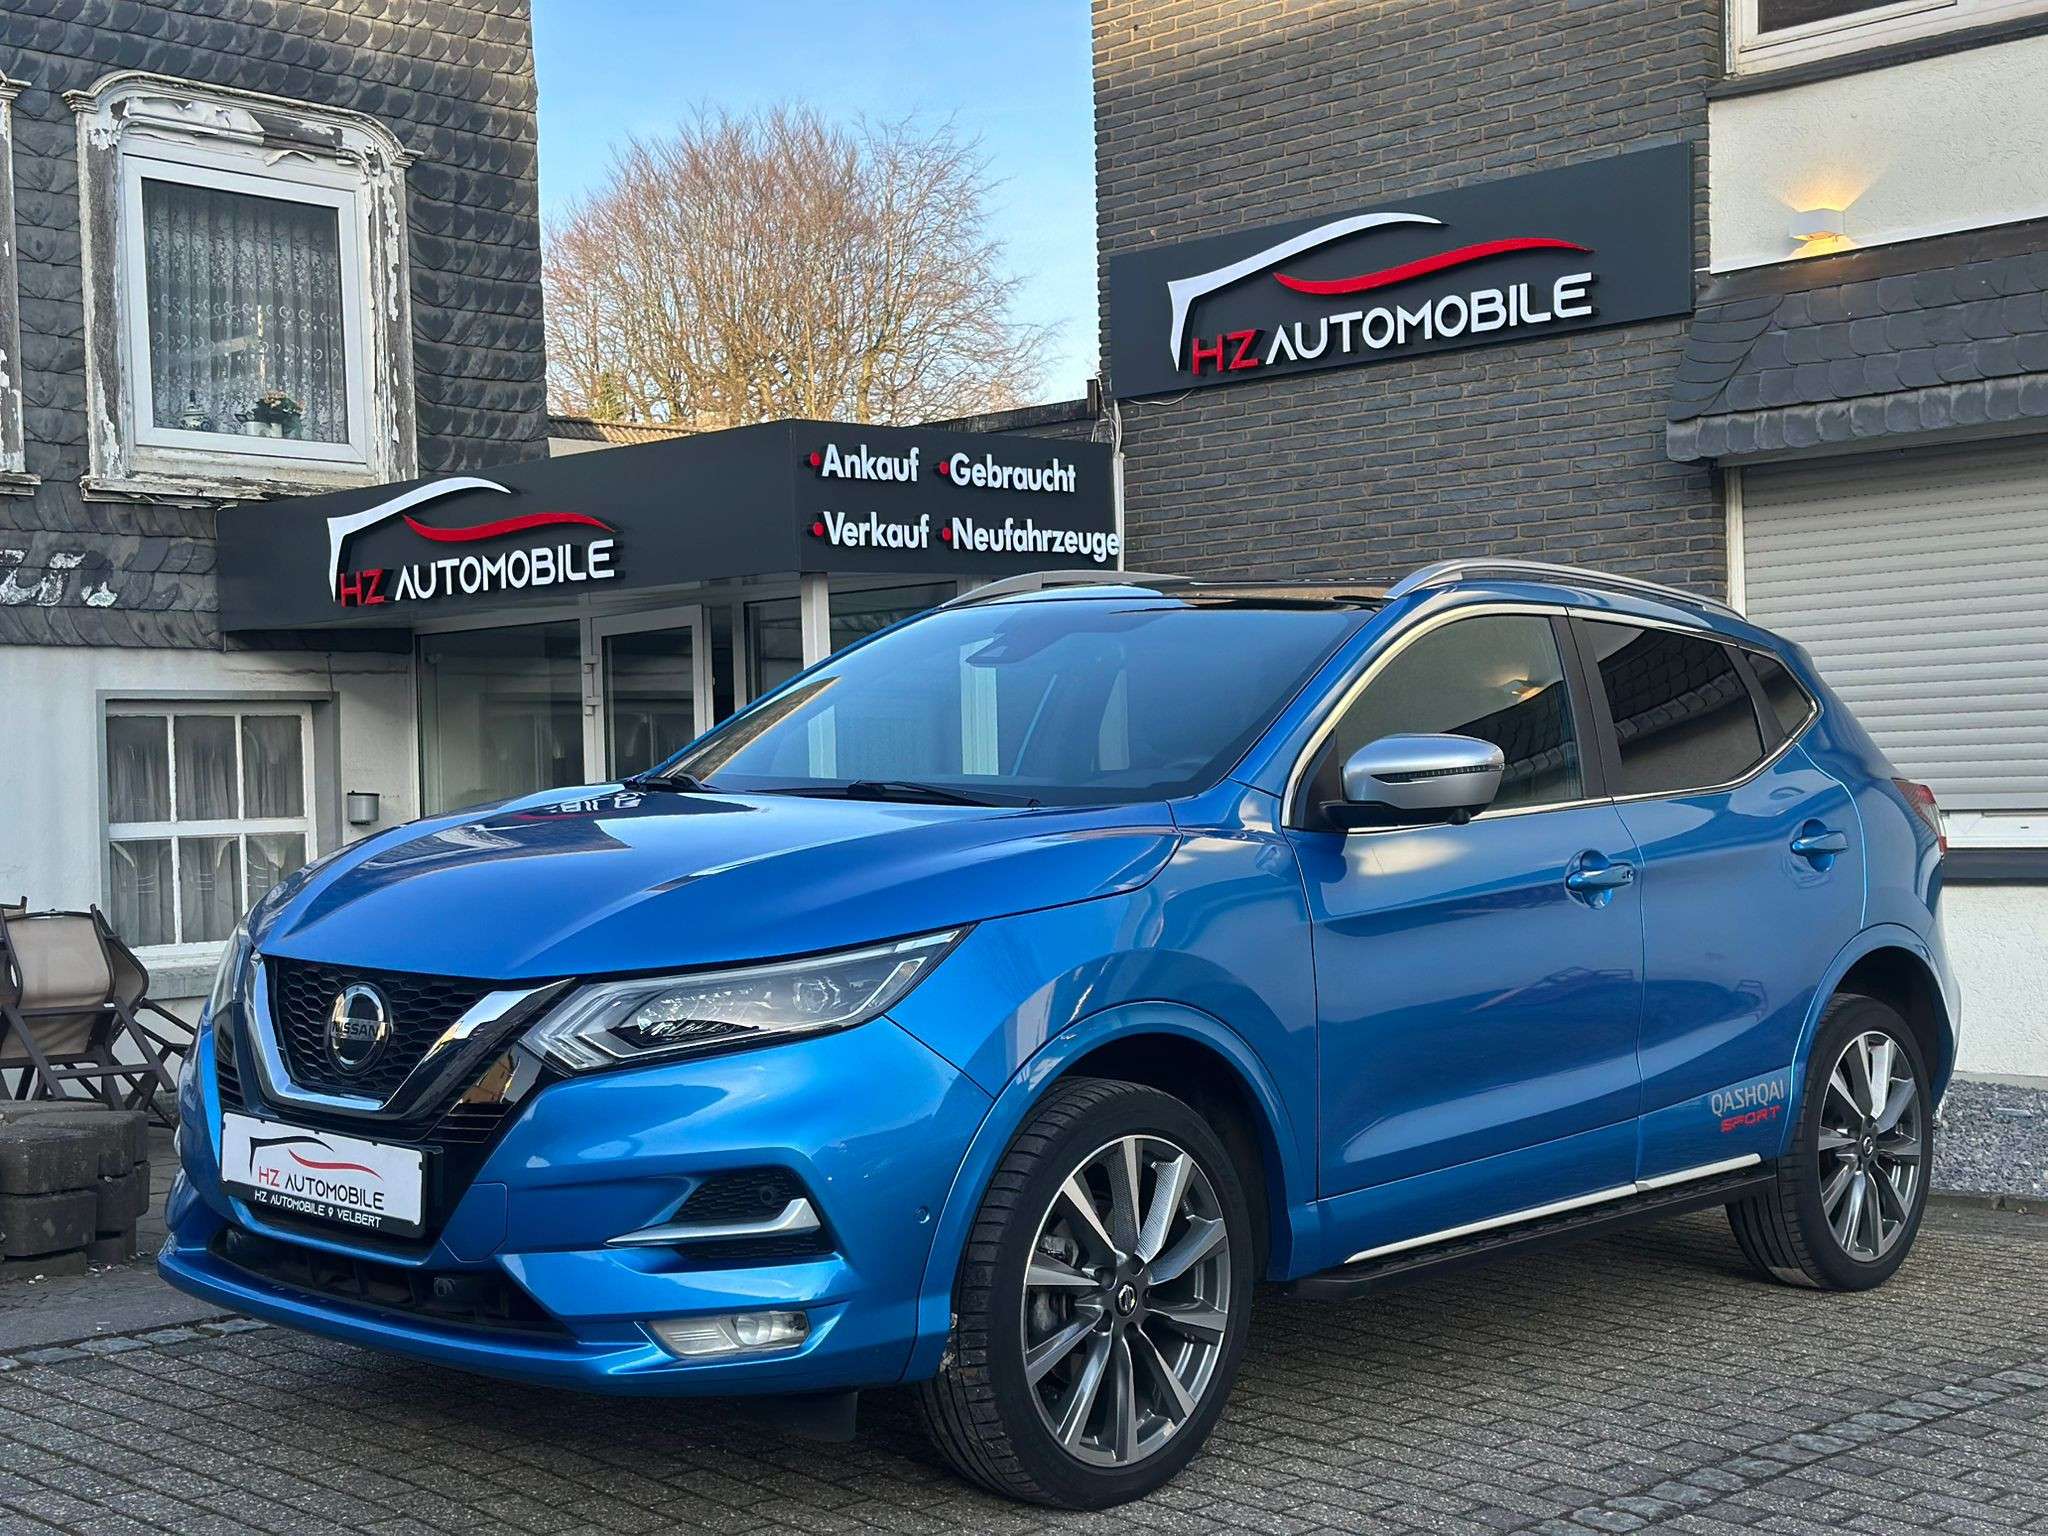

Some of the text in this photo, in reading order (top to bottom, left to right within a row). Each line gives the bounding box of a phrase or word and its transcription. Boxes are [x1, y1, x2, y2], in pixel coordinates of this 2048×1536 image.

[1191, 271, 1594, 376] HZ AUTOMOBILE
[821, 443, 1077, 493] Ankauf Gebraucht
[823, 511, 1120, 563] Verkauf Neufahrzeuge
[339, 538, 616, 608] HZ AUTOMOBILE
[1711, 1079, 1785, 1118] QASHQAI
[1721, 1104, 1782, 1133] SPORT
[254, 1190, 382, 1229] HZ AUTOMOBILE VELBERT
[258, 1166, 385, 1211] HZ AUTOMOBILE
